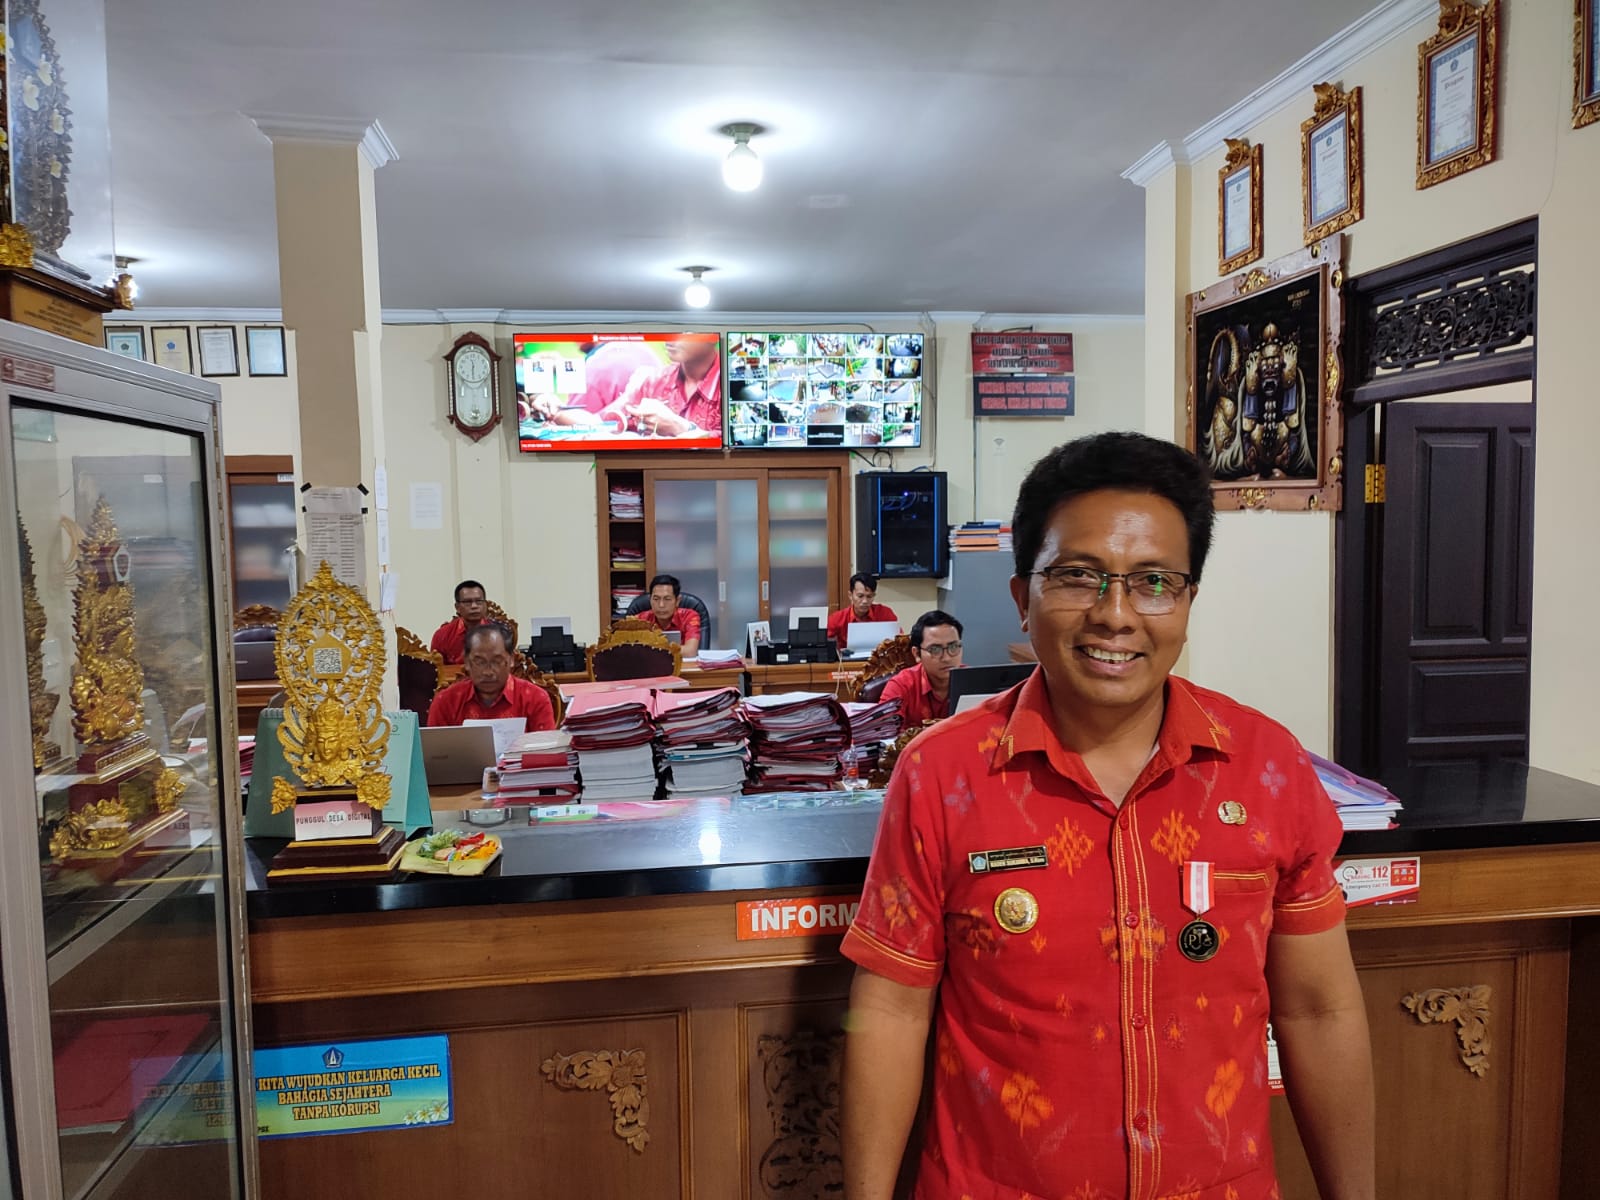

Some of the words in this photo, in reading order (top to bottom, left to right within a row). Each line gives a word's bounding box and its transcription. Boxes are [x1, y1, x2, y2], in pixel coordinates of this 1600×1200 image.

[296, 815, 325, 824] PUNGGUL
[328, 814, 344, 822] DESA
[347, 812, 371, 821] DIGITAL
[1372, 865, 1388, 879] 112
[751, 904, 858, 931] INFORM
[257, 1076, 286, 1092] KITA
[286, 1071, 346, 1090] WUJUDKAN
[347, 1066, 406, 1084] KELUARGA
[407, 1063, 441, 1080] KECIL
[278, 1088, 329, 1105] BAHAGIA
[329, 1083, 393, 1104] SEJAHTERA
[293, 1104, 330, 1120] TANPA
[330, 1100, 381, 1118] KORUPSI
